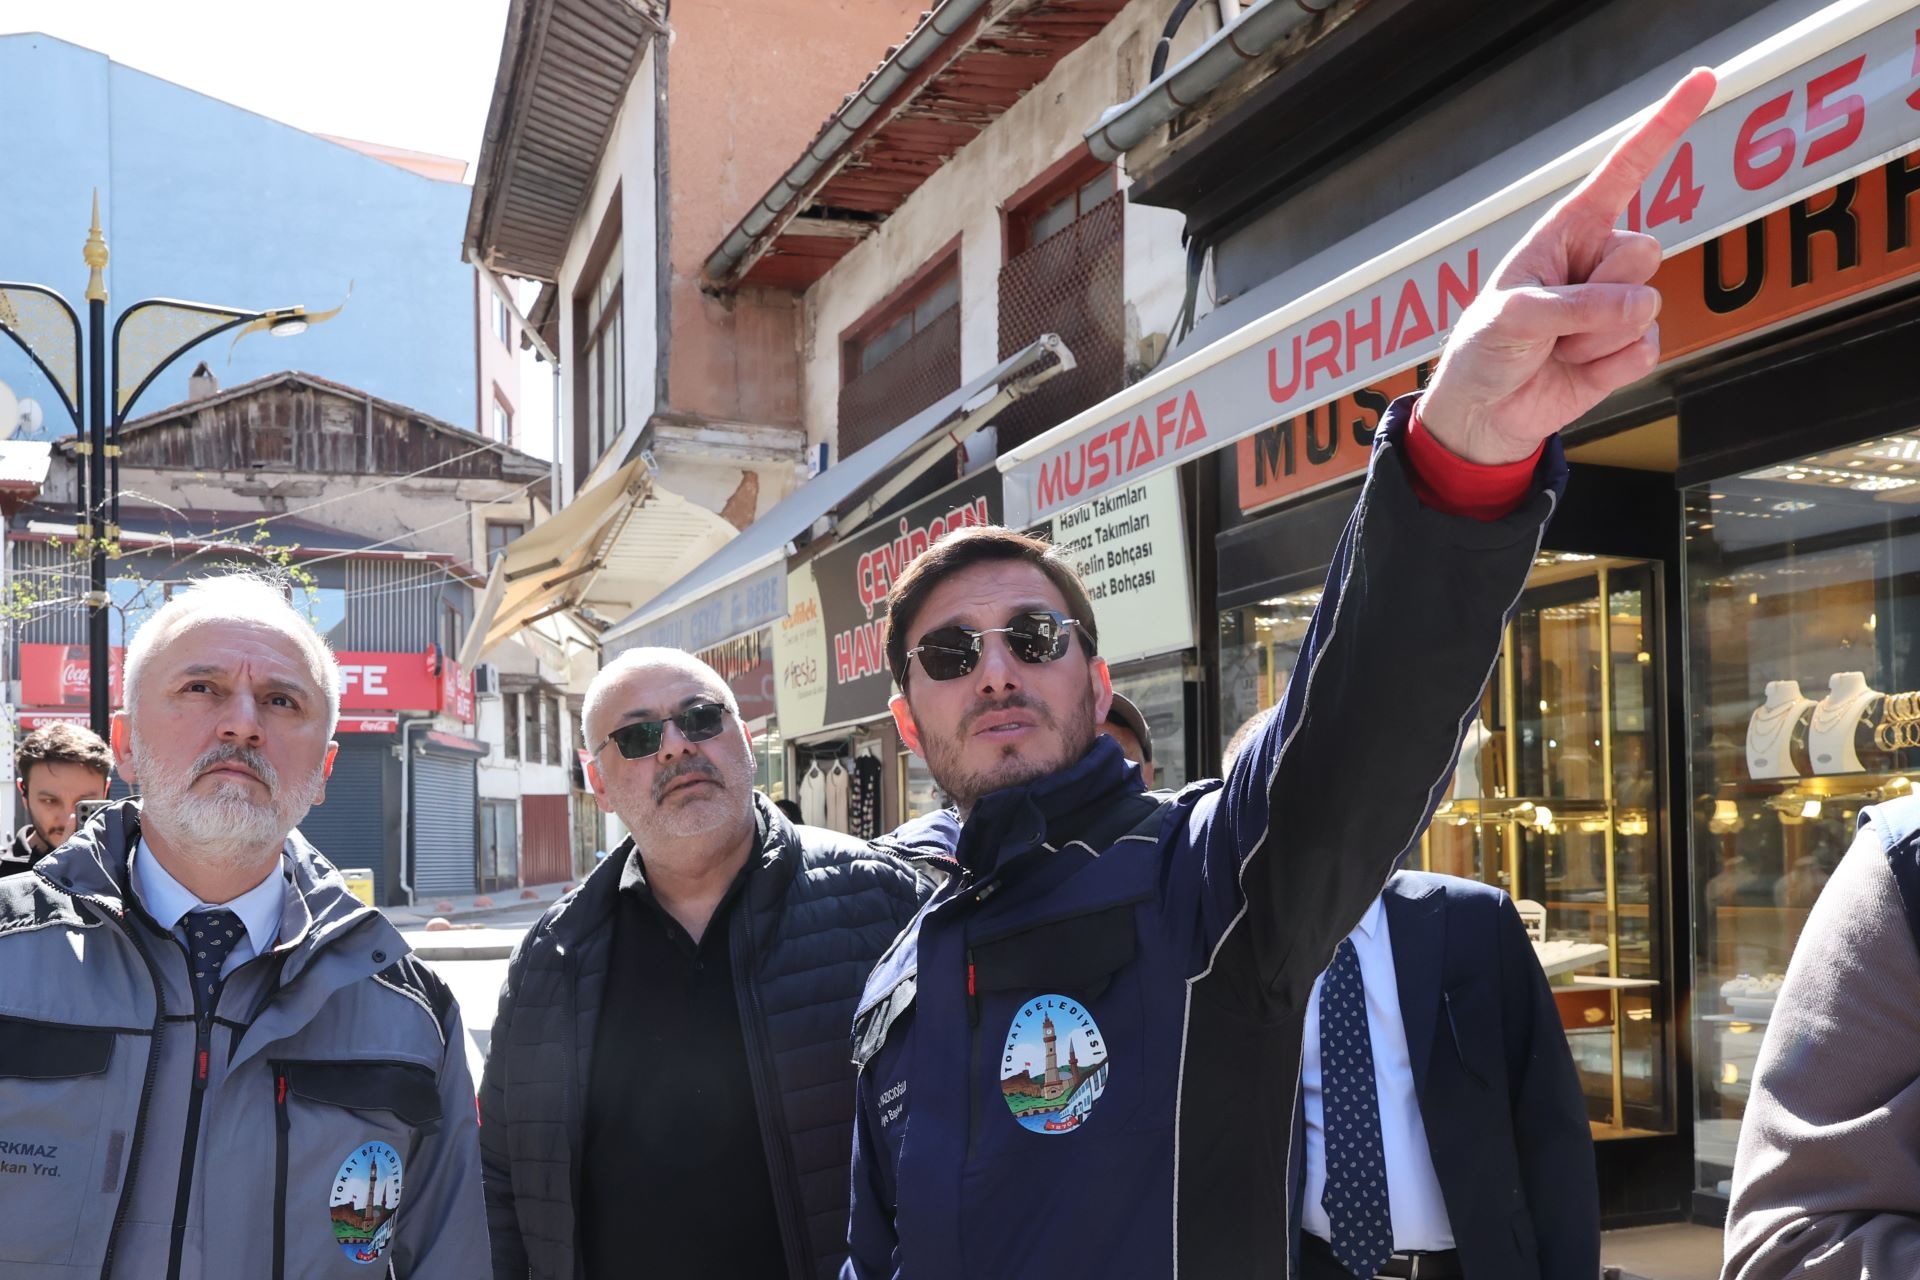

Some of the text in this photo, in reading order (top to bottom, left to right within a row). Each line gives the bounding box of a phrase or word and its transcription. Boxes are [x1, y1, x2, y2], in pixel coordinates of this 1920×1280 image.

[1037, 389, 1208, 511] MUSTAFA
[1268, 248, 1478, 404] URHAN
[1733, 54, 1867, 191] 65
[1060, 485, 1148, 531] Havlu Takımları
[1095, 513, 1151, 544] Takımları
[1107, 541, 1153, 567] Bohçası
[1110, 570, 1156, 595] Bohçası
[834, 615, 891, 685] HAV
[1003, 1022, 1023, 1074] TOKAT
[32, 1163, 62, 1178] Yrd.
[334, 1158, 358, 1201] TOKAT
